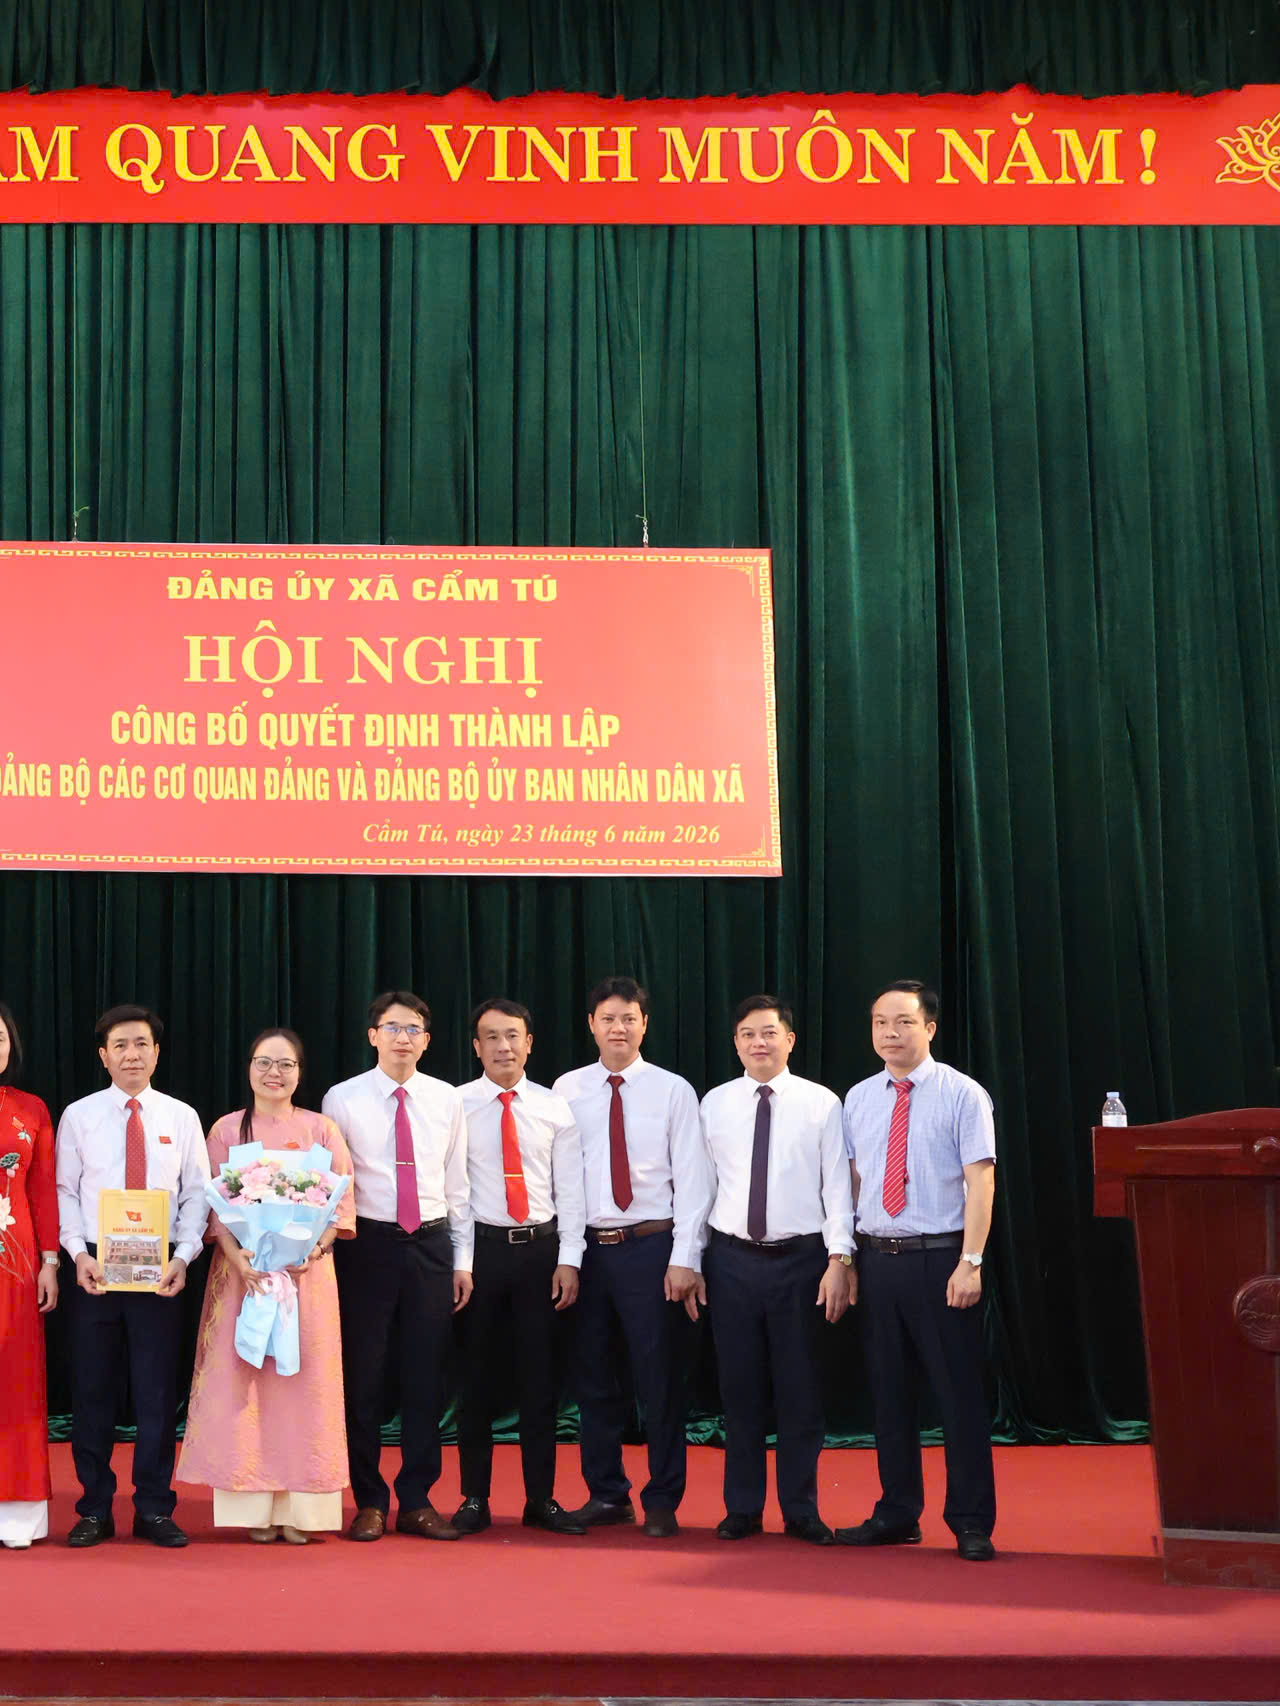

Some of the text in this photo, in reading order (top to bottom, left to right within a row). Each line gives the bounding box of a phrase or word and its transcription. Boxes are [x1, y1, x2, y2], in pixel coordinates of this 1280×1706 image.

[105, 123, 406, 194] QUANG
[425, 124, 639, 183] VINH
[658, 109, 916, 184] MUÔN
[167, 569, 558, 603] ĐẢNG ỦY XÃ CẨM TÚ
[183, 619, 544, 699] HỘI NGHỊ
[111, 700, 621, 756] CÔNG BỐ QUYẾT ĐỊNH THÀNH LẬP
[59, 757, 91, 806] BỘ
[98, 757, 147, 800] CÁC
[153, 762, 187, 800] CƠ
[192, 765, 257, 804] QUAN
[263, 755, 330, 802] ĐẢNG
[336, 760, 369, 802] VÀ
[373, 756, 441, 802] ĐẢNG
[447, 760, 481, 809] BỘ
[487, 756, 518, 802] ỦY
[524, 767, 575, 802] BAN
[580, 761, 649, 803] NHÂN
[655, 761, 708, 803] DÂN
[711, 763, 746, 803] XÃ
[362, 818, 721, 848] Cẩm Tú, ngày 23 tháng 6 năm 2026
